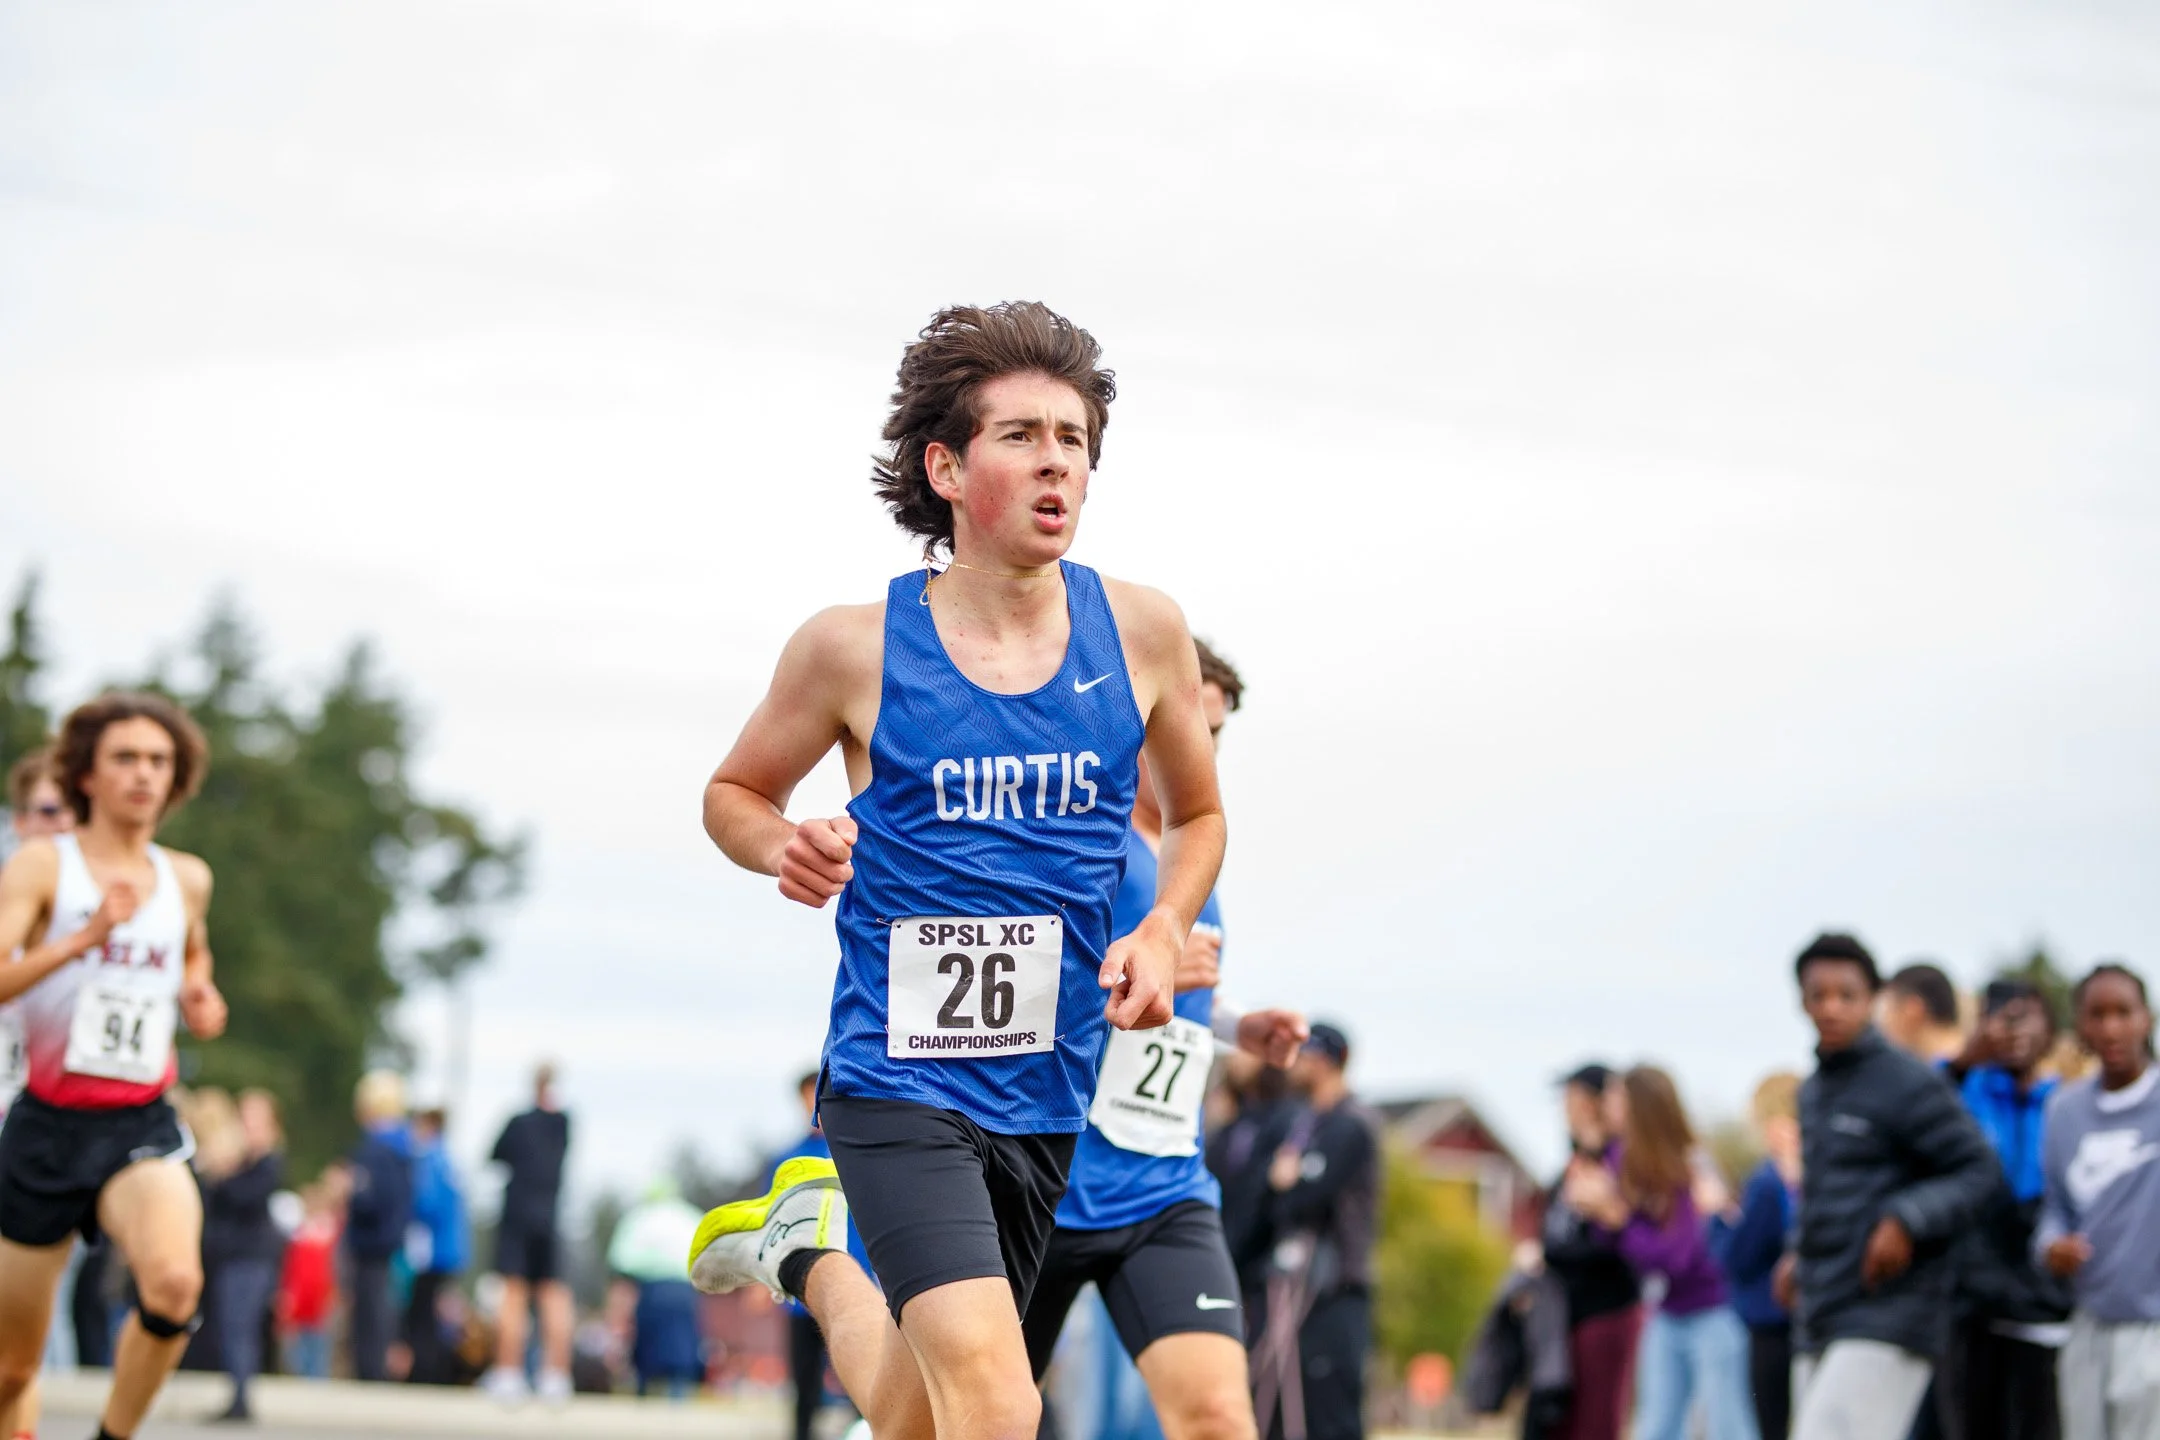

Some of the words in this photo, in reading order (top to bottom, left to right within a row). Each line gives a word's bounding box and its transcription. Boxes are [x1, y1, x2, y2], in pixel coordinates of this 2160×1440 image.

[932, 750, 1101, 822] CURTIS
[918, 923, 991, 947] SPSL
[999, 923, 1035, 946] XC
[936, 952, 1016, 1030] 26
[102, 1013, 143, 1053] 94
[908, 1031, 1037, 1050] CHAMPIONSHIPS
[1135, 1042, 1187, 1103] 27
